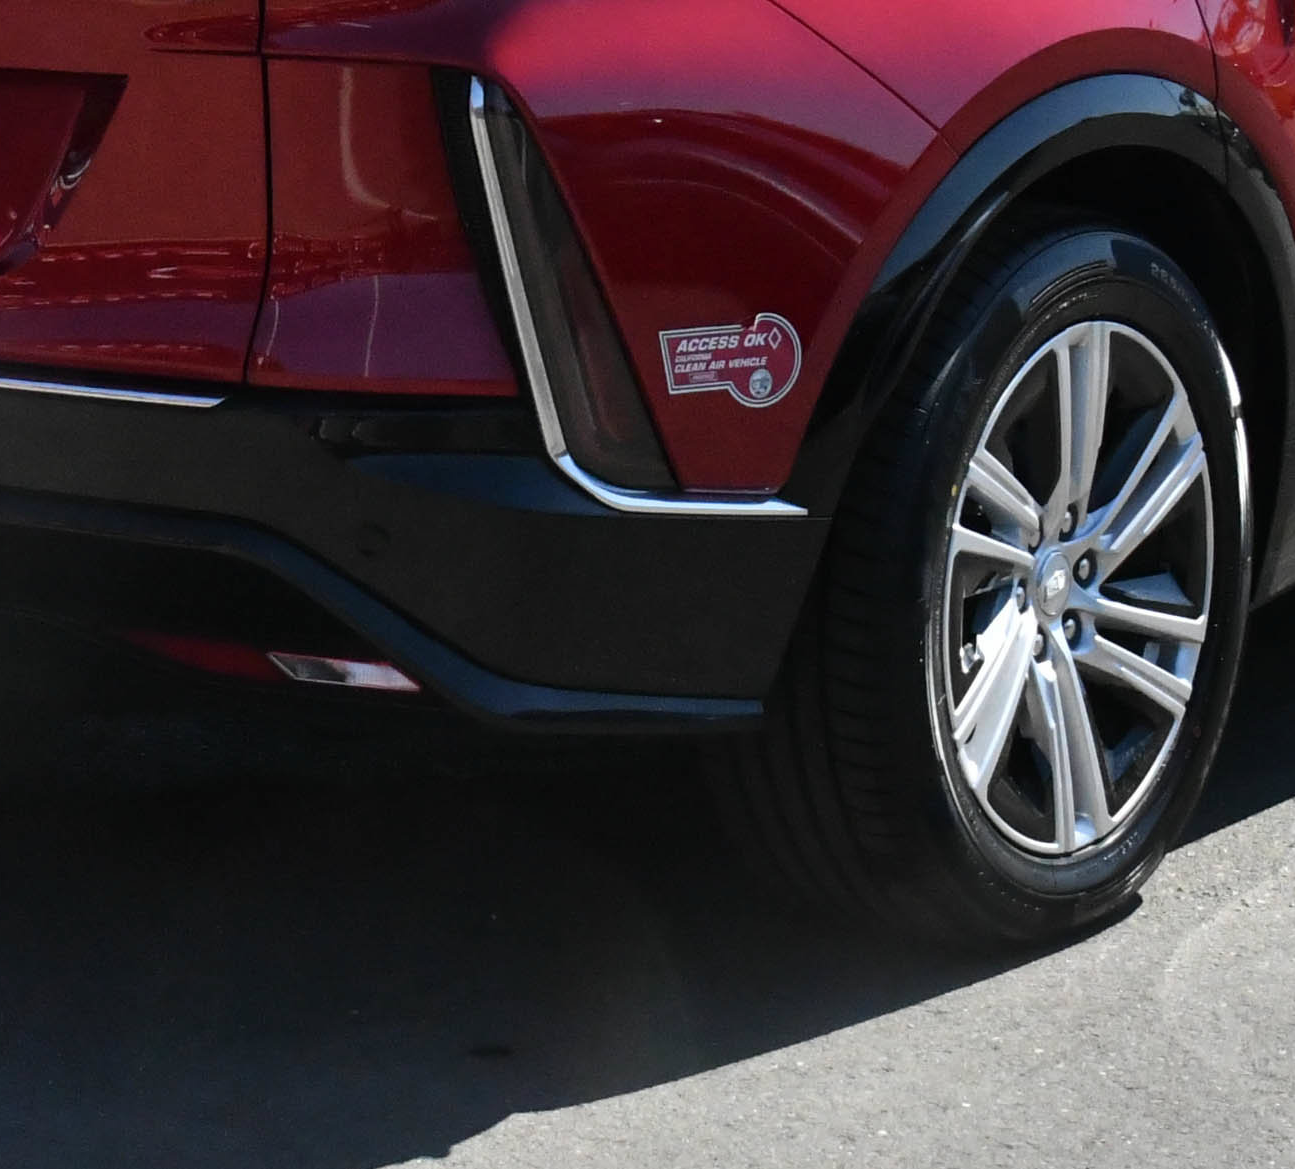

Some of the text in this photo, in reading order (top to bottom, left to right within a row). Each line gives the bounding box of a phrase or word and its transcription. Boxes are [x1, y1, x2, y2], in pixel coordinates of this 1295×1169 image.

[676, 333, 768, 352] ACCESS OK
[674, 356, 768, 373] CLEAN AIR VEHICLE
